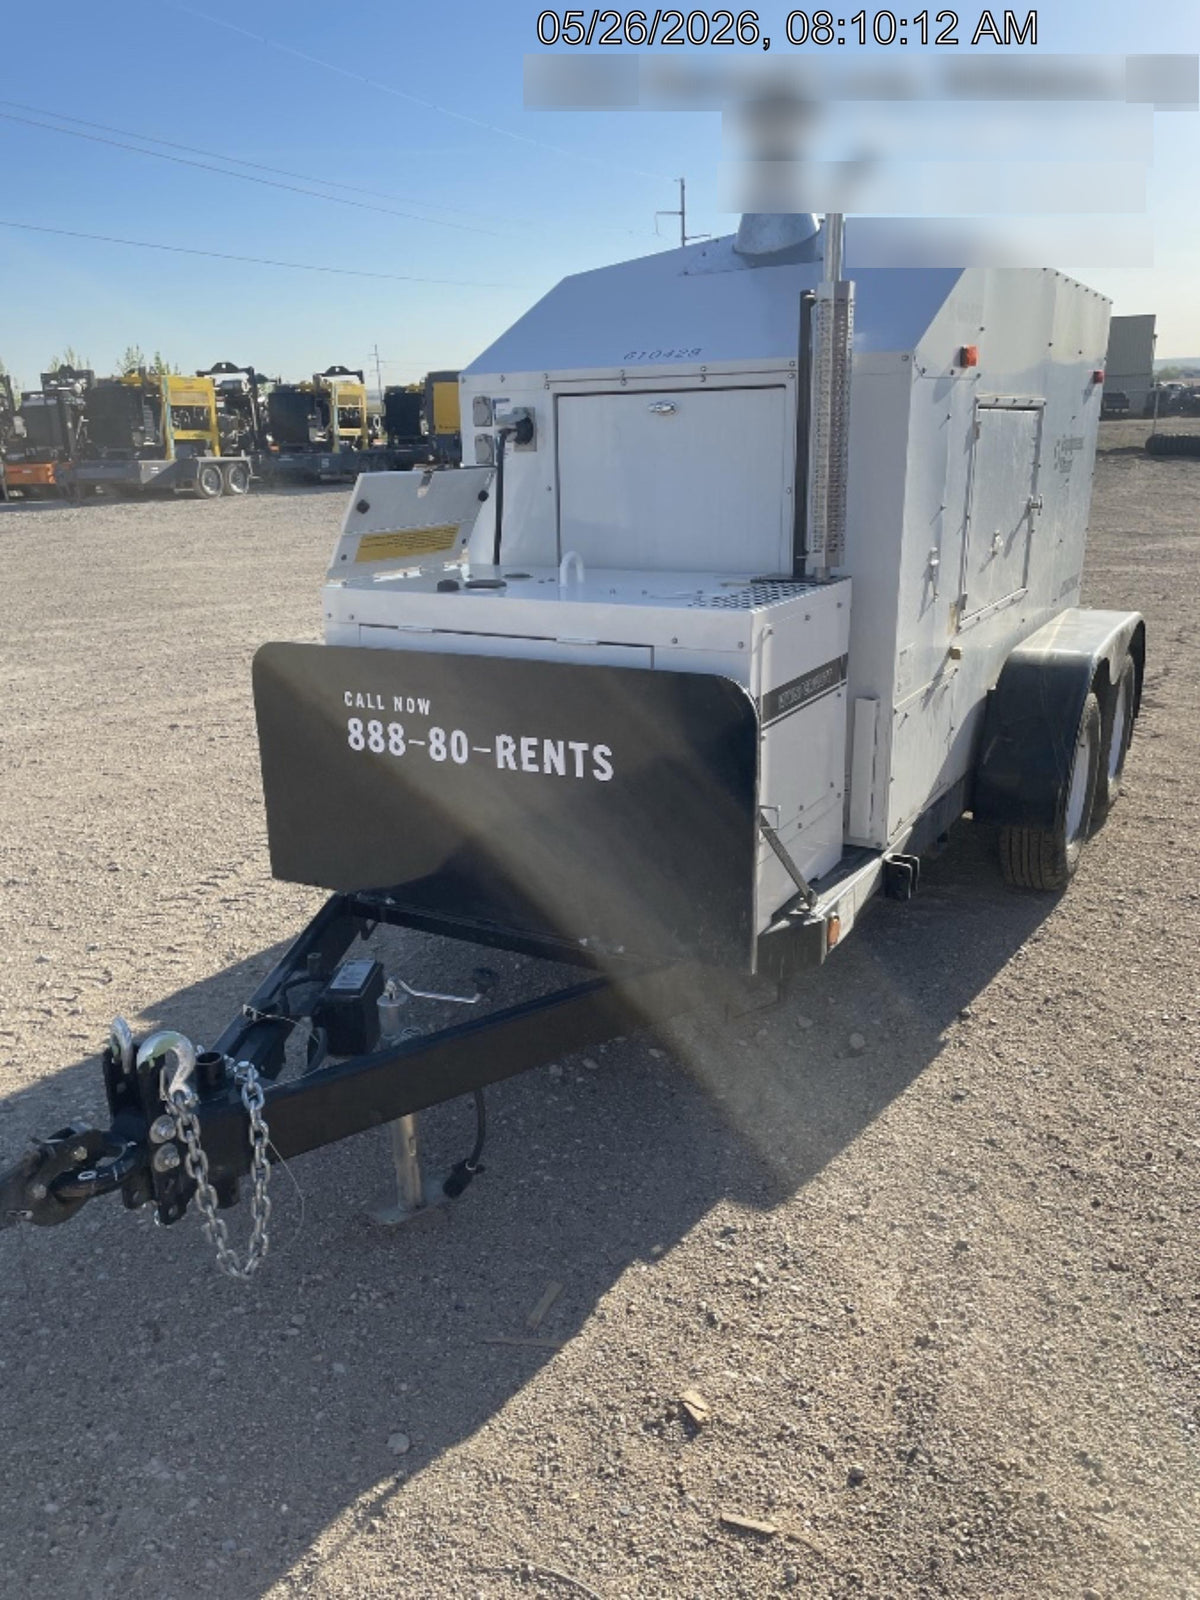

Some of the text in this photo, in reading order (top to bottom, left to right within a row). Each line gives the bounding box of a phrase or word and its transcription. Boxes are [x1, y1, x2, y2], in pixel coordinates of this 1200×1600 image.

[344, 690, 431, 716] CALL NOW
[347, 717, 614, 782] 888-80-RENTS
